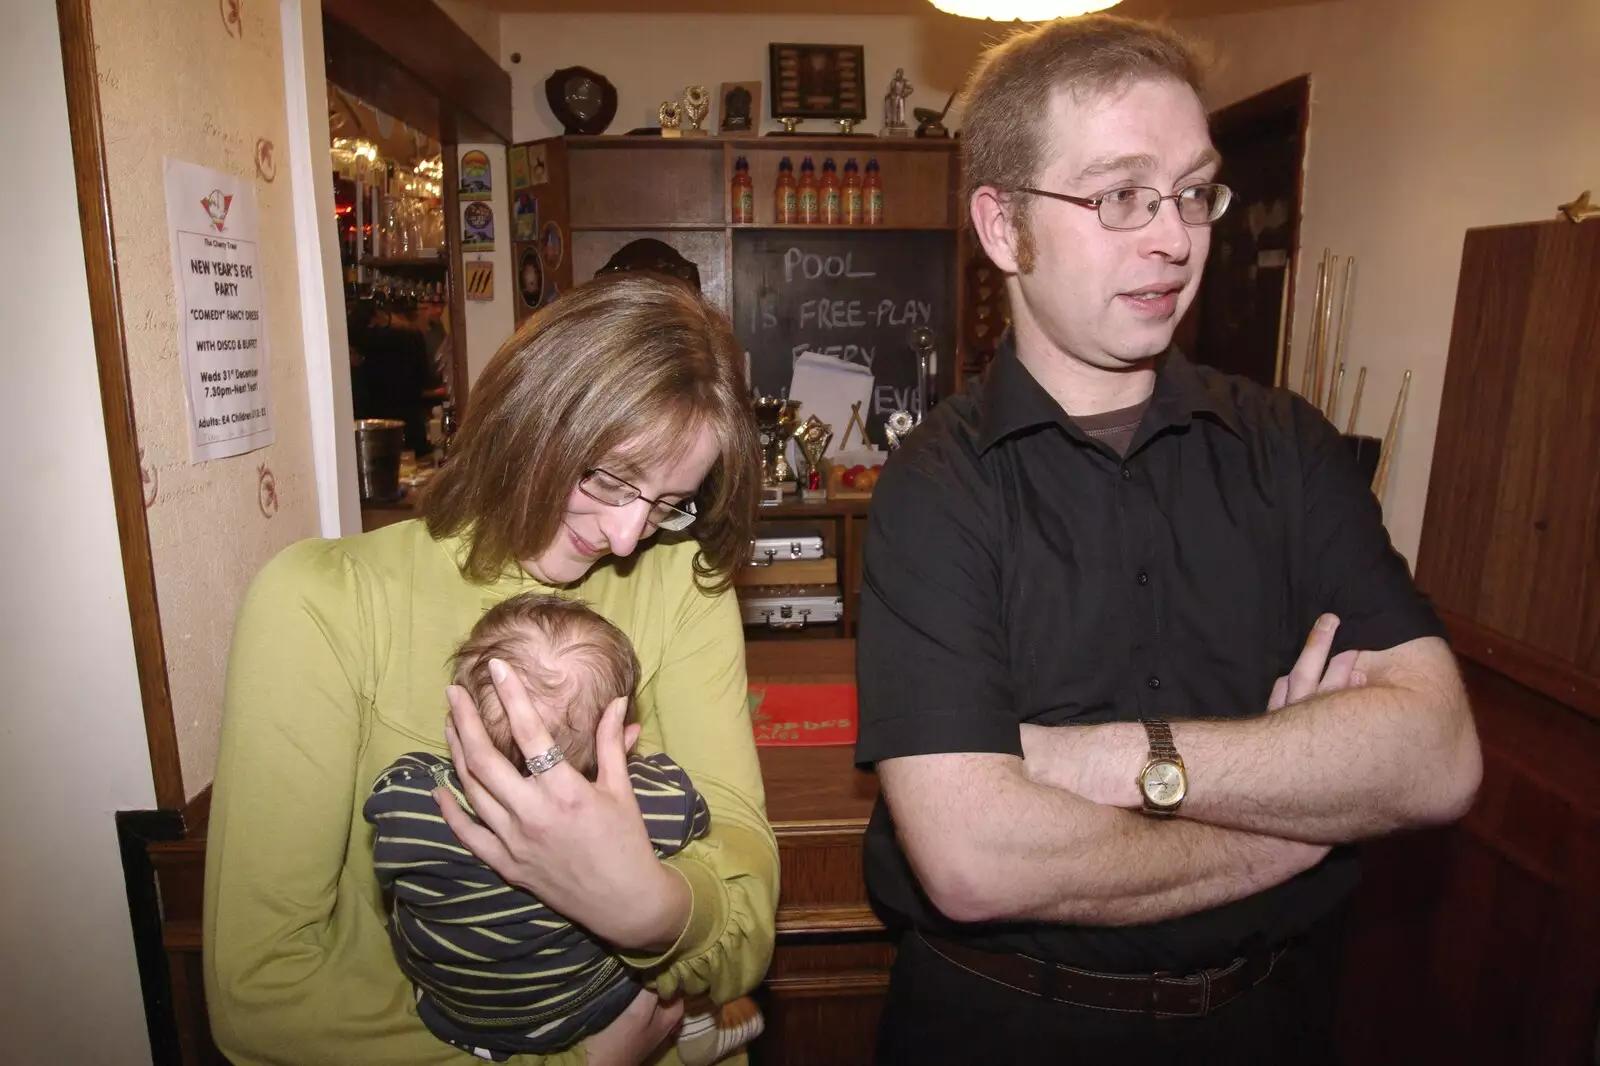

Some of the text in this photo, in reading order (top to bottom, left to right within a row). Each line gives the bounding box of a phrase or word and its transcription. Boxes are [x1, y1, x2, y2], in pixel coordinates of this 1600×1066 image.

[204, 238, 212, 247] The
[227, 241, 237, 250] Tree
[190, 259, 253, 279] NEW YEAR'S EVE
[784, 247, 876, 282] POOL
[214, 281, 238, 296] PARTY
[226, 310, 244, 320] FANCY
[245, 310, 260, 320] DRESS
[750, 298, 931, 333] IS FREE-PLAY
[196, 338, 258, 352] WITH DISCO & BUFFET
[200, 371, 221, 382] Weds
[235, 369, 258, 380] December
[199, 417, 221, 429] Adults:
[231, 412, 252, 423] Children
